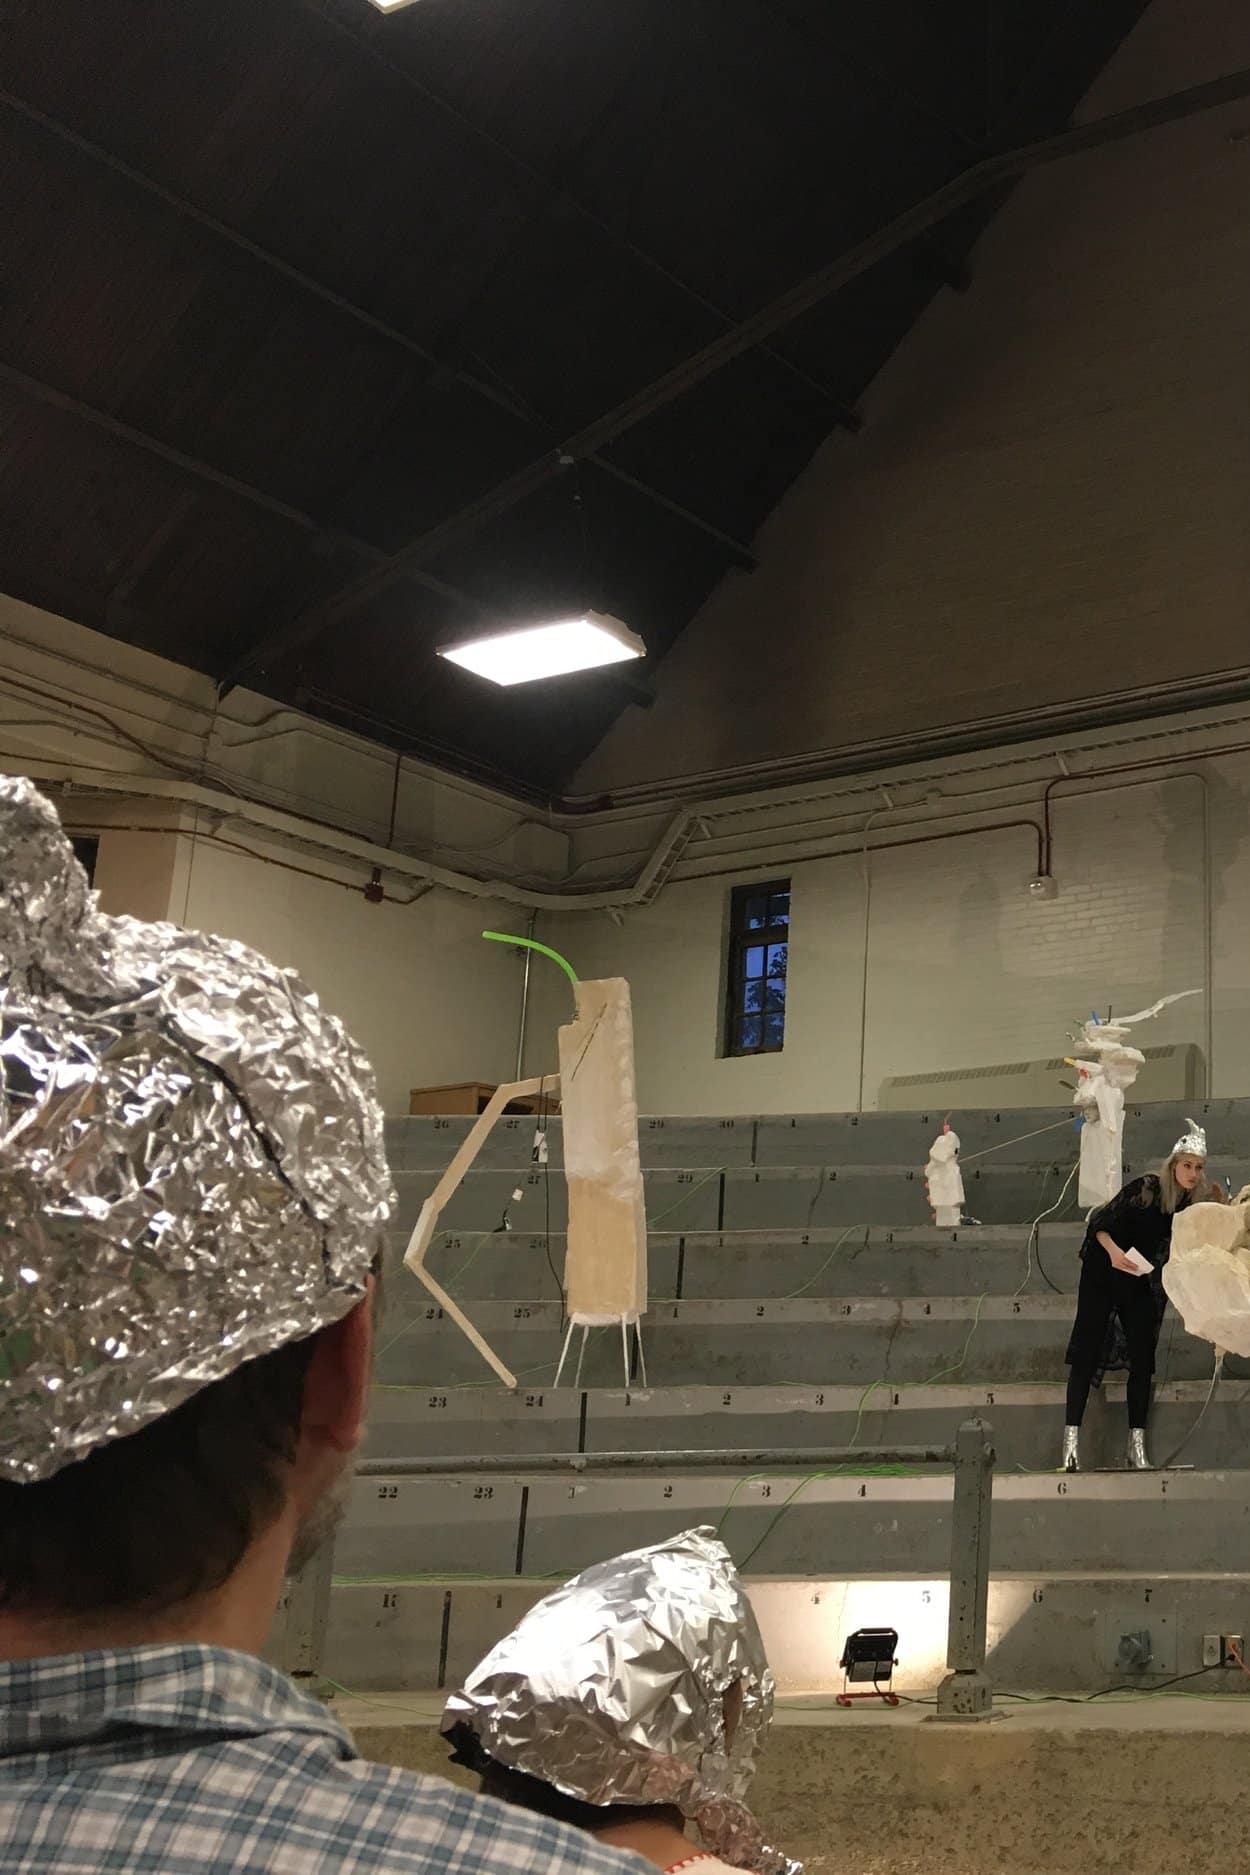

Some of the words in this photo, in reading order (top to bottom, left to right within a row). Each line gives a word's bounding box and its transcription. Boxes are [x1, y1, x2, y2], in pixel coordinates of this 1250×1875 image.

[829, 1171, 837, 1181] 2
[445, 1238, 460, 1249] 25
[514, 1307, 530, 1319] 25
[755, 1305, 765, 1317] 2
[428, 1396, 447, 1408] 23
[722, 1394, 732, 1406] 2
[815, 1394, 825, 1406] 3
[985, 1393, 995, 1405] 5
[663, 1486, 674, 1499] 2
[761, 1485, 772, 1498] 3
[1057, 1482, 1068, 1495] 6
[1161, 1480, 1169, 1493] 7
[378, 1487, 398, 1500] 22
[474, 1487, 493, 1500] 23
[921, 1590, 931, 1603] 5
[1032, 1589, 1044, 1603] 6
[1143, 1588, 1153, 1603] 7
